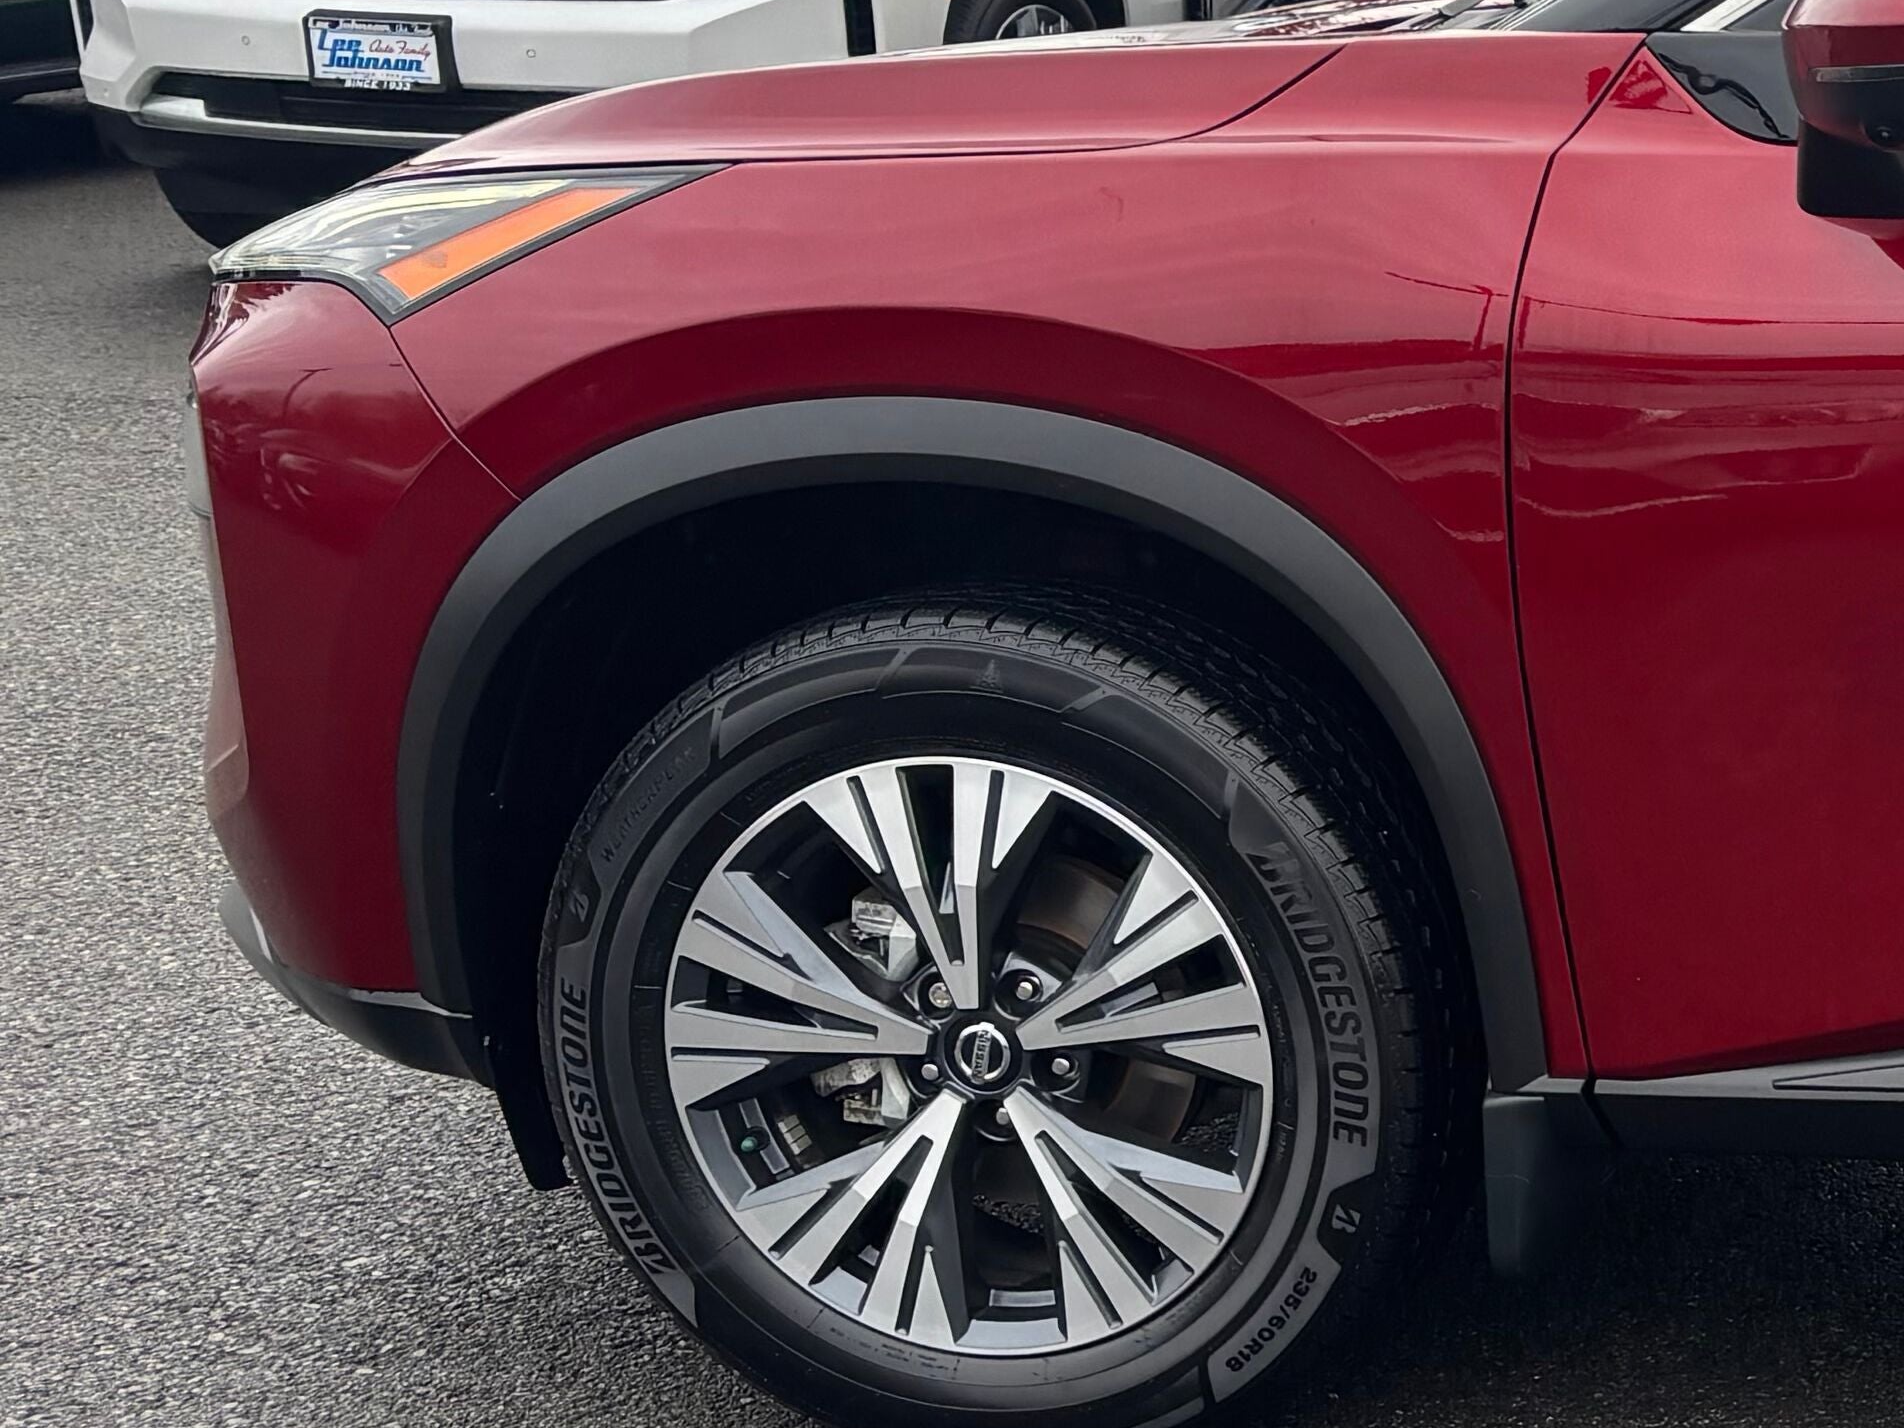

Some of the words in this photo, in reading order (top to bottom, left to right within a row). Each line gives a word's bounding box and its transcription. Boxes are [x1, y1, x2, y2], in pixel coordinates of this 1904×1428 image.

[318, 29, 365, 53] Lee
[321, 47, 427, 73] Johnson
[1245, 840, 1369, 1149] BRIDGESTONE
[560, 976, 677, 1274] BRIDGESTONE
[1225, 1267, 1317, 1372] 235/60R18
